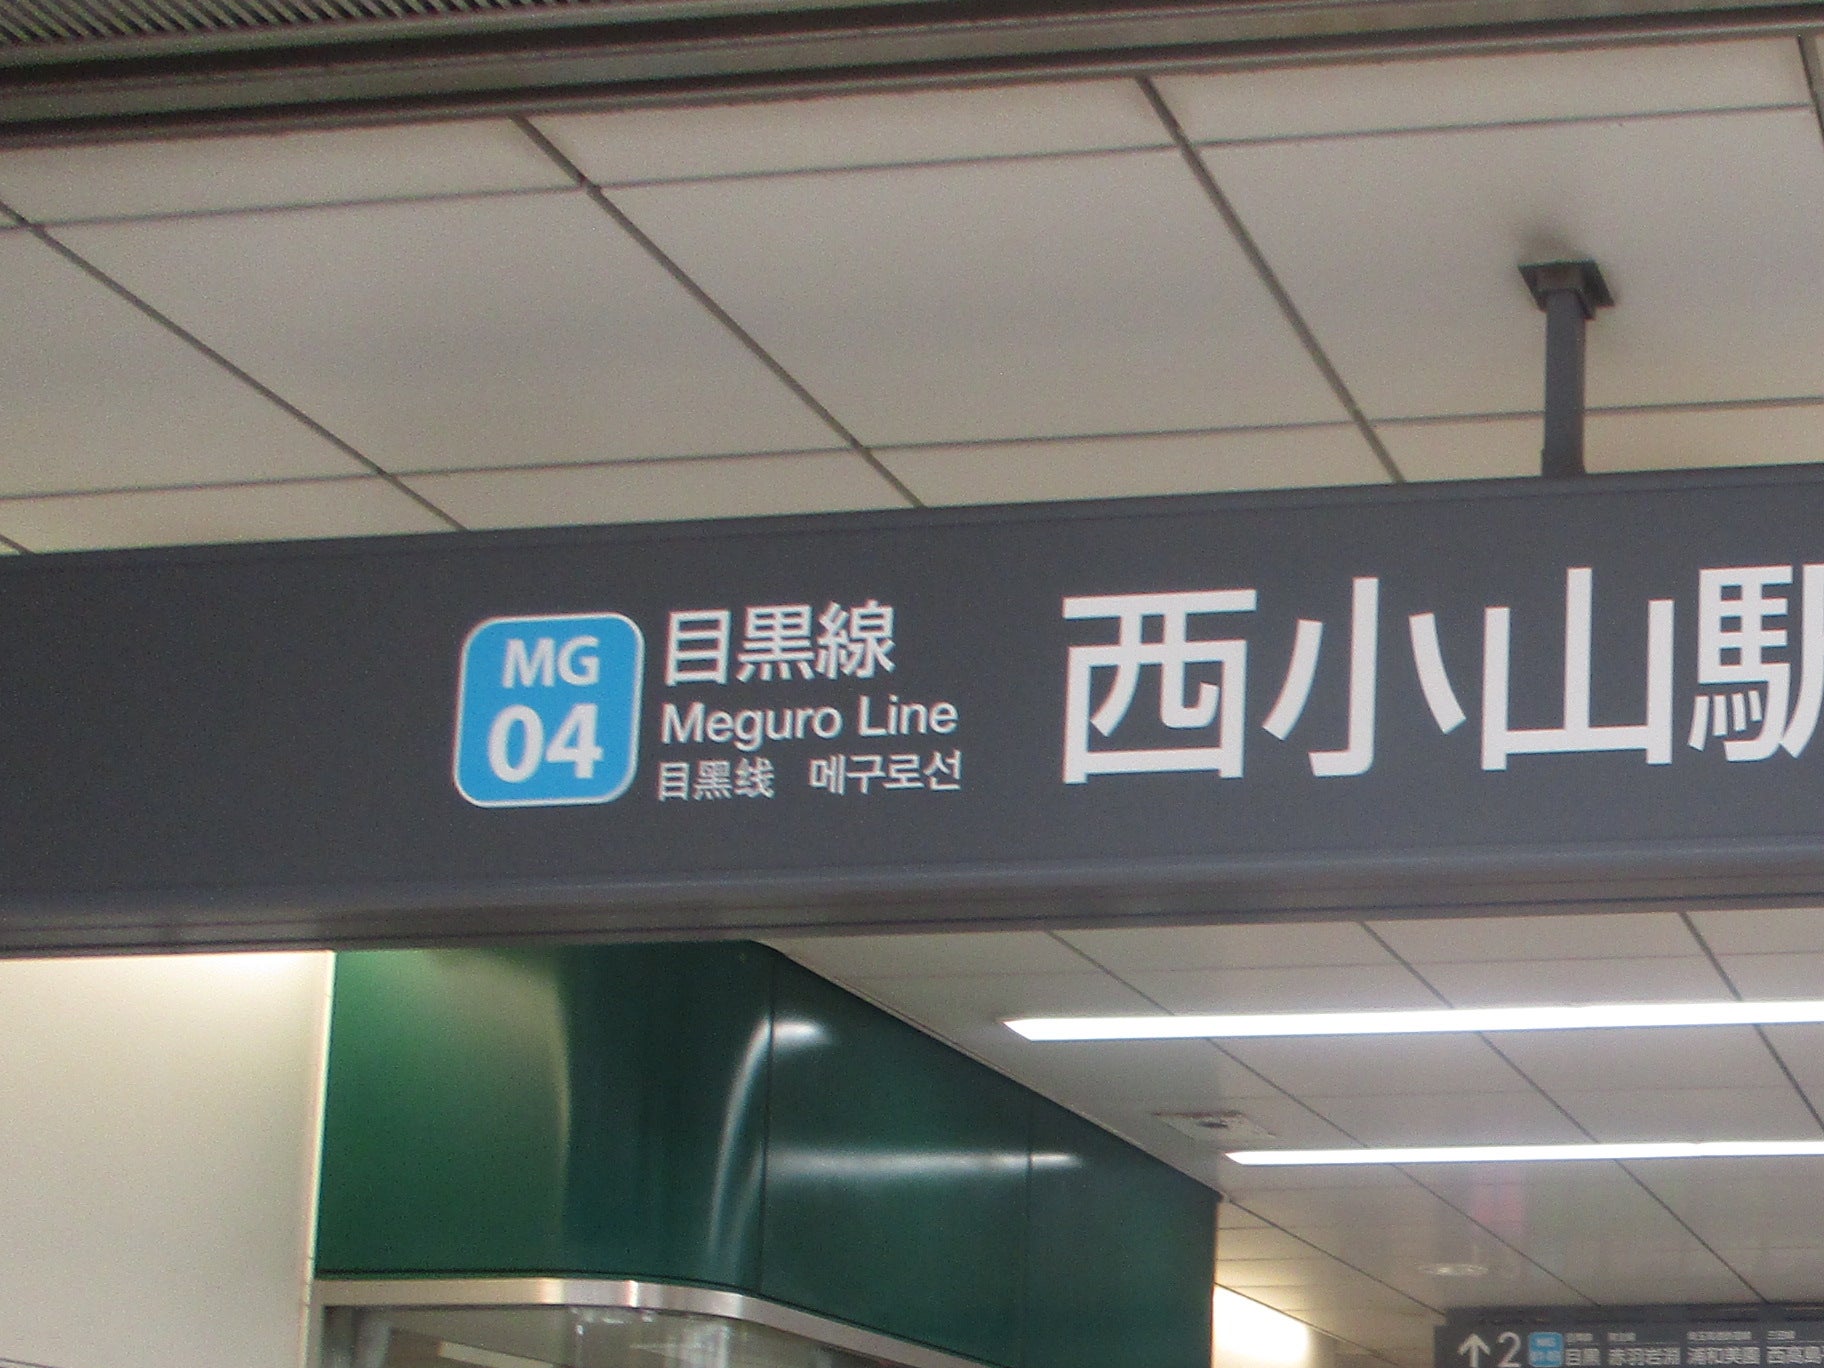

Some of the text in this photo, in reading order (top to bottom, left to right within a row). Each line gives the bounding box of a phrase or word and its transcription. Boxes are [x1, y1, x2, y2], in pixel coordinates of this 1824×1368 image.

[503, 635, 599, 689] MG
[664, 600, 896, 687] 目黒線
[487, 703, 603, 784] 04
[661, 694, 958, 752] Meguro Line
[809, 750, 963, 796] 메구로선
[1498, 1331, 1522, 1368] 2
